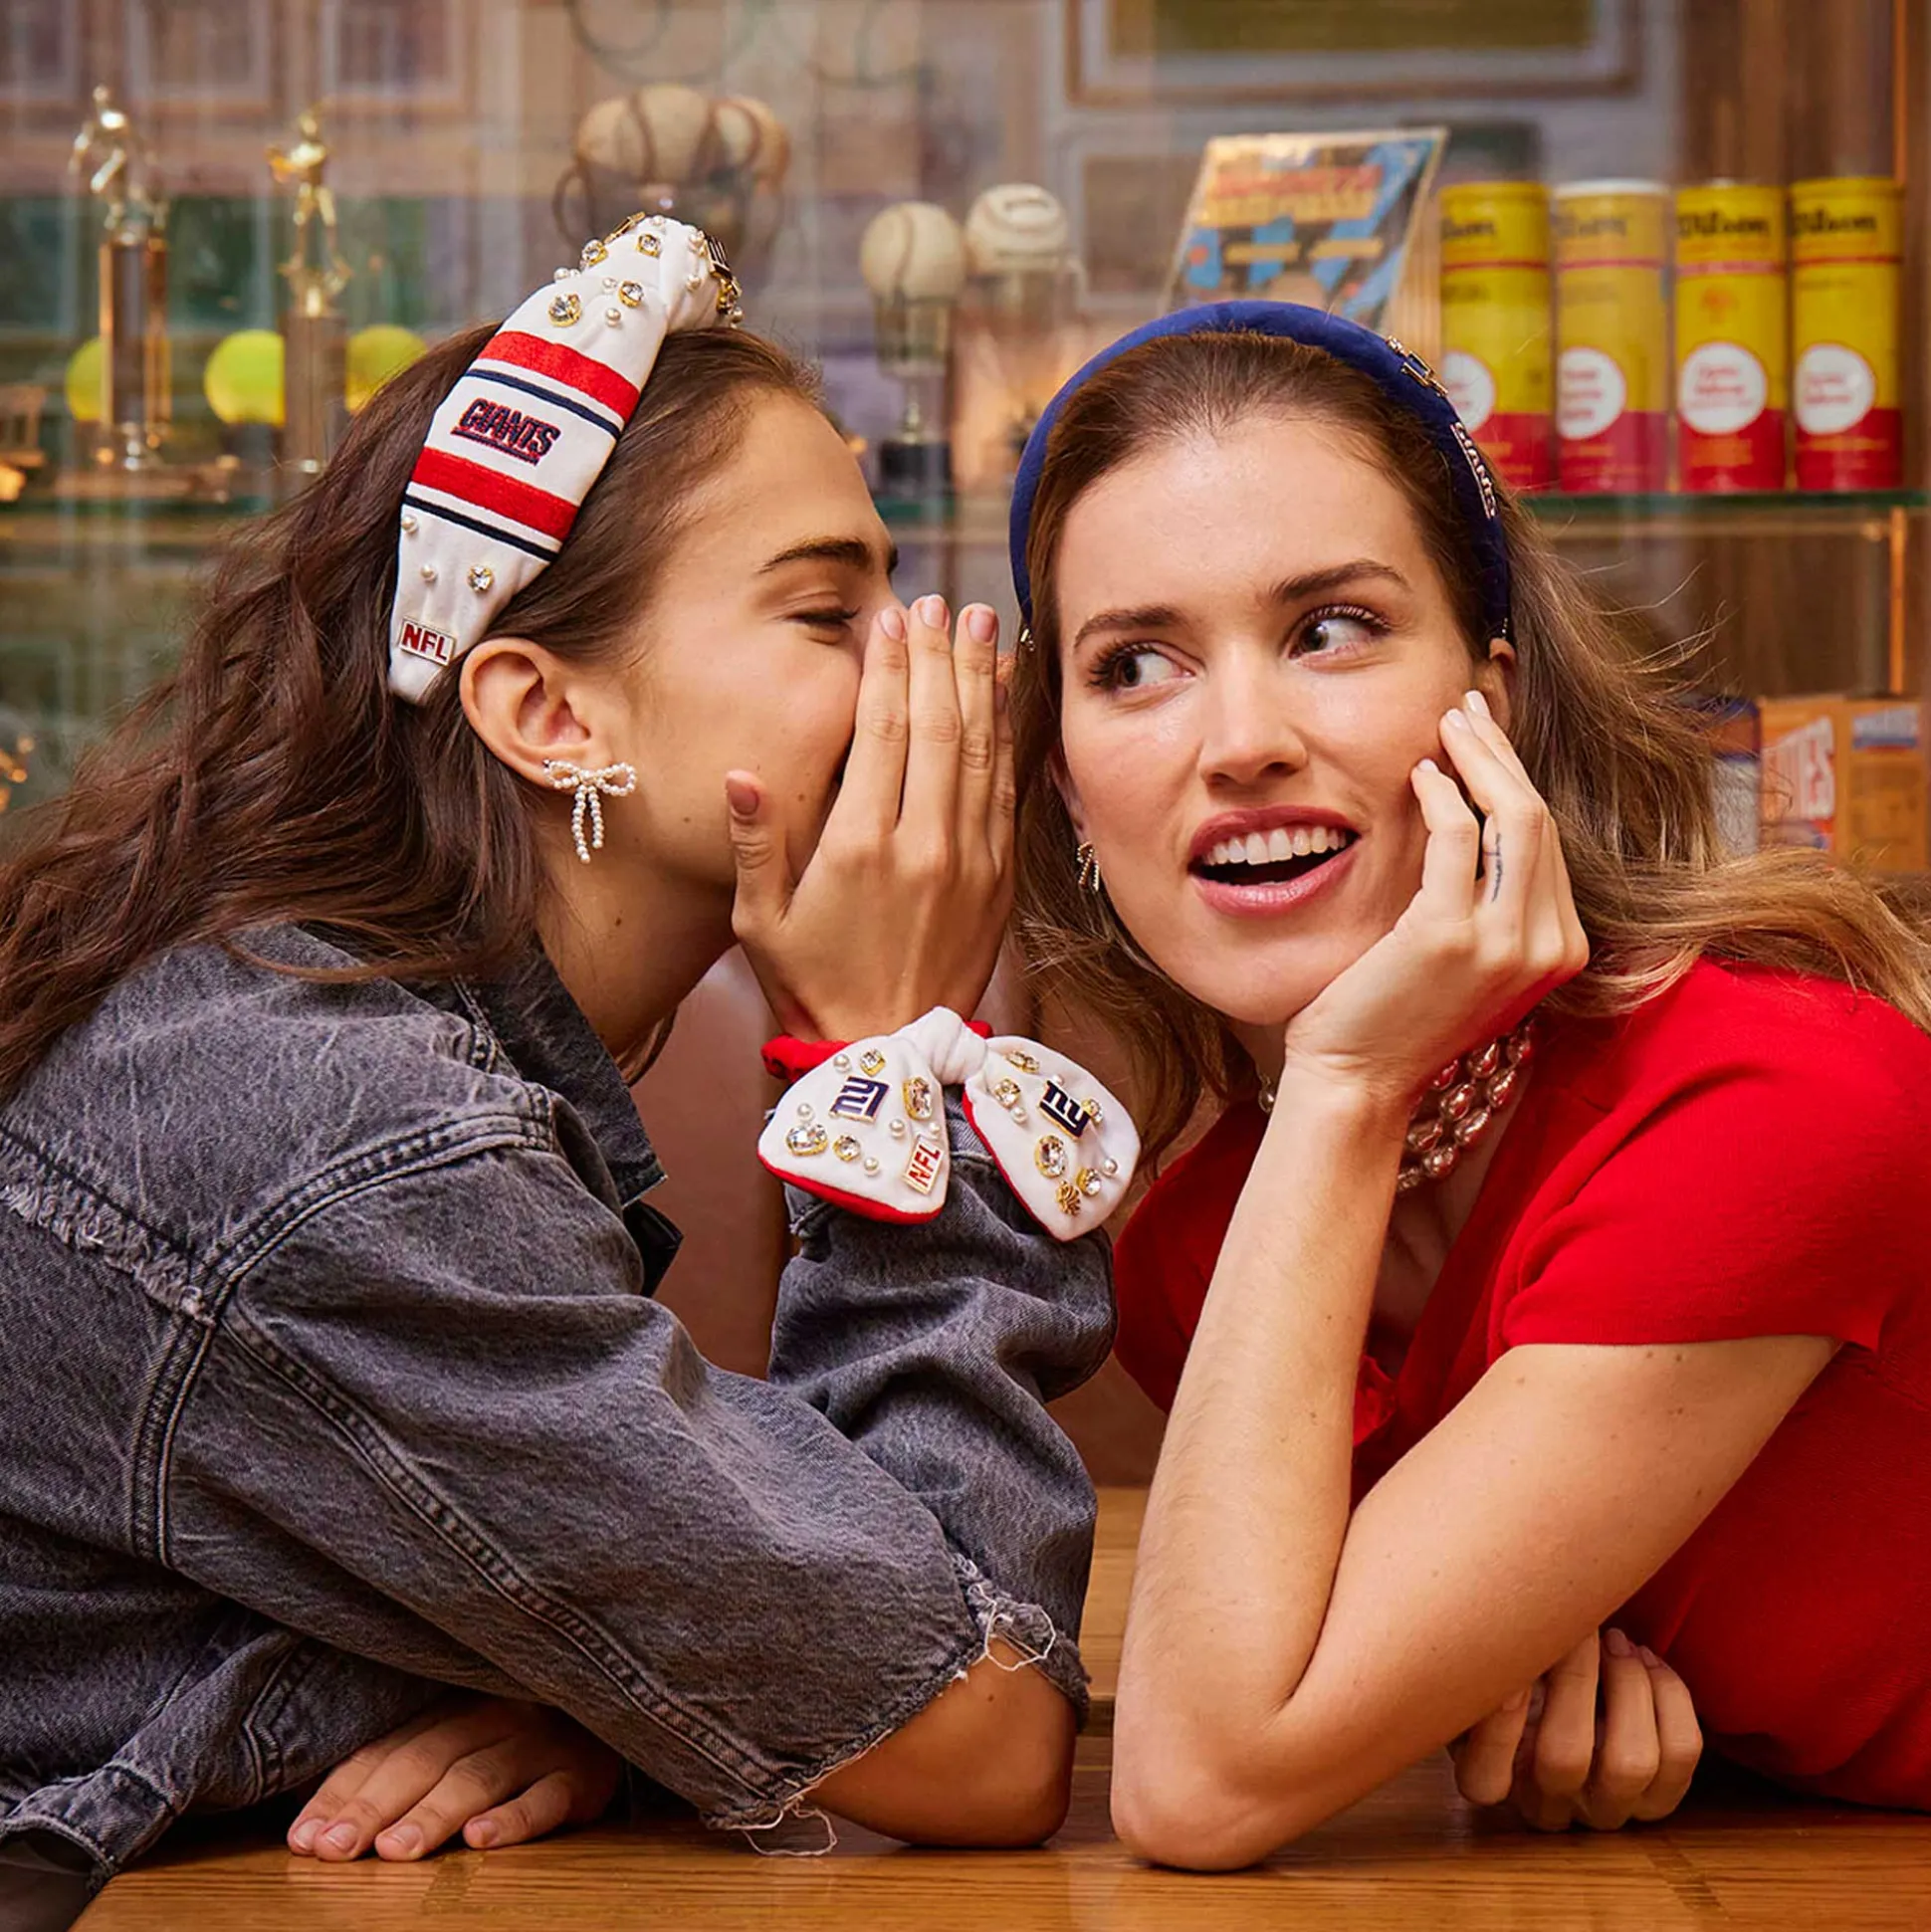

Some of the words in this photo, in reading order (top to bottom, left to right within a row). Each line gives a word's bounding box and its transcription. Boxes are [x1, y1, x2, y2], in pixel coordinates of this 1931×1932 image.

[457, 397, 561, 459] GIANTS
[401, 623, 448, 661] NFL
[907, 1144, 942, 1188] NFL
